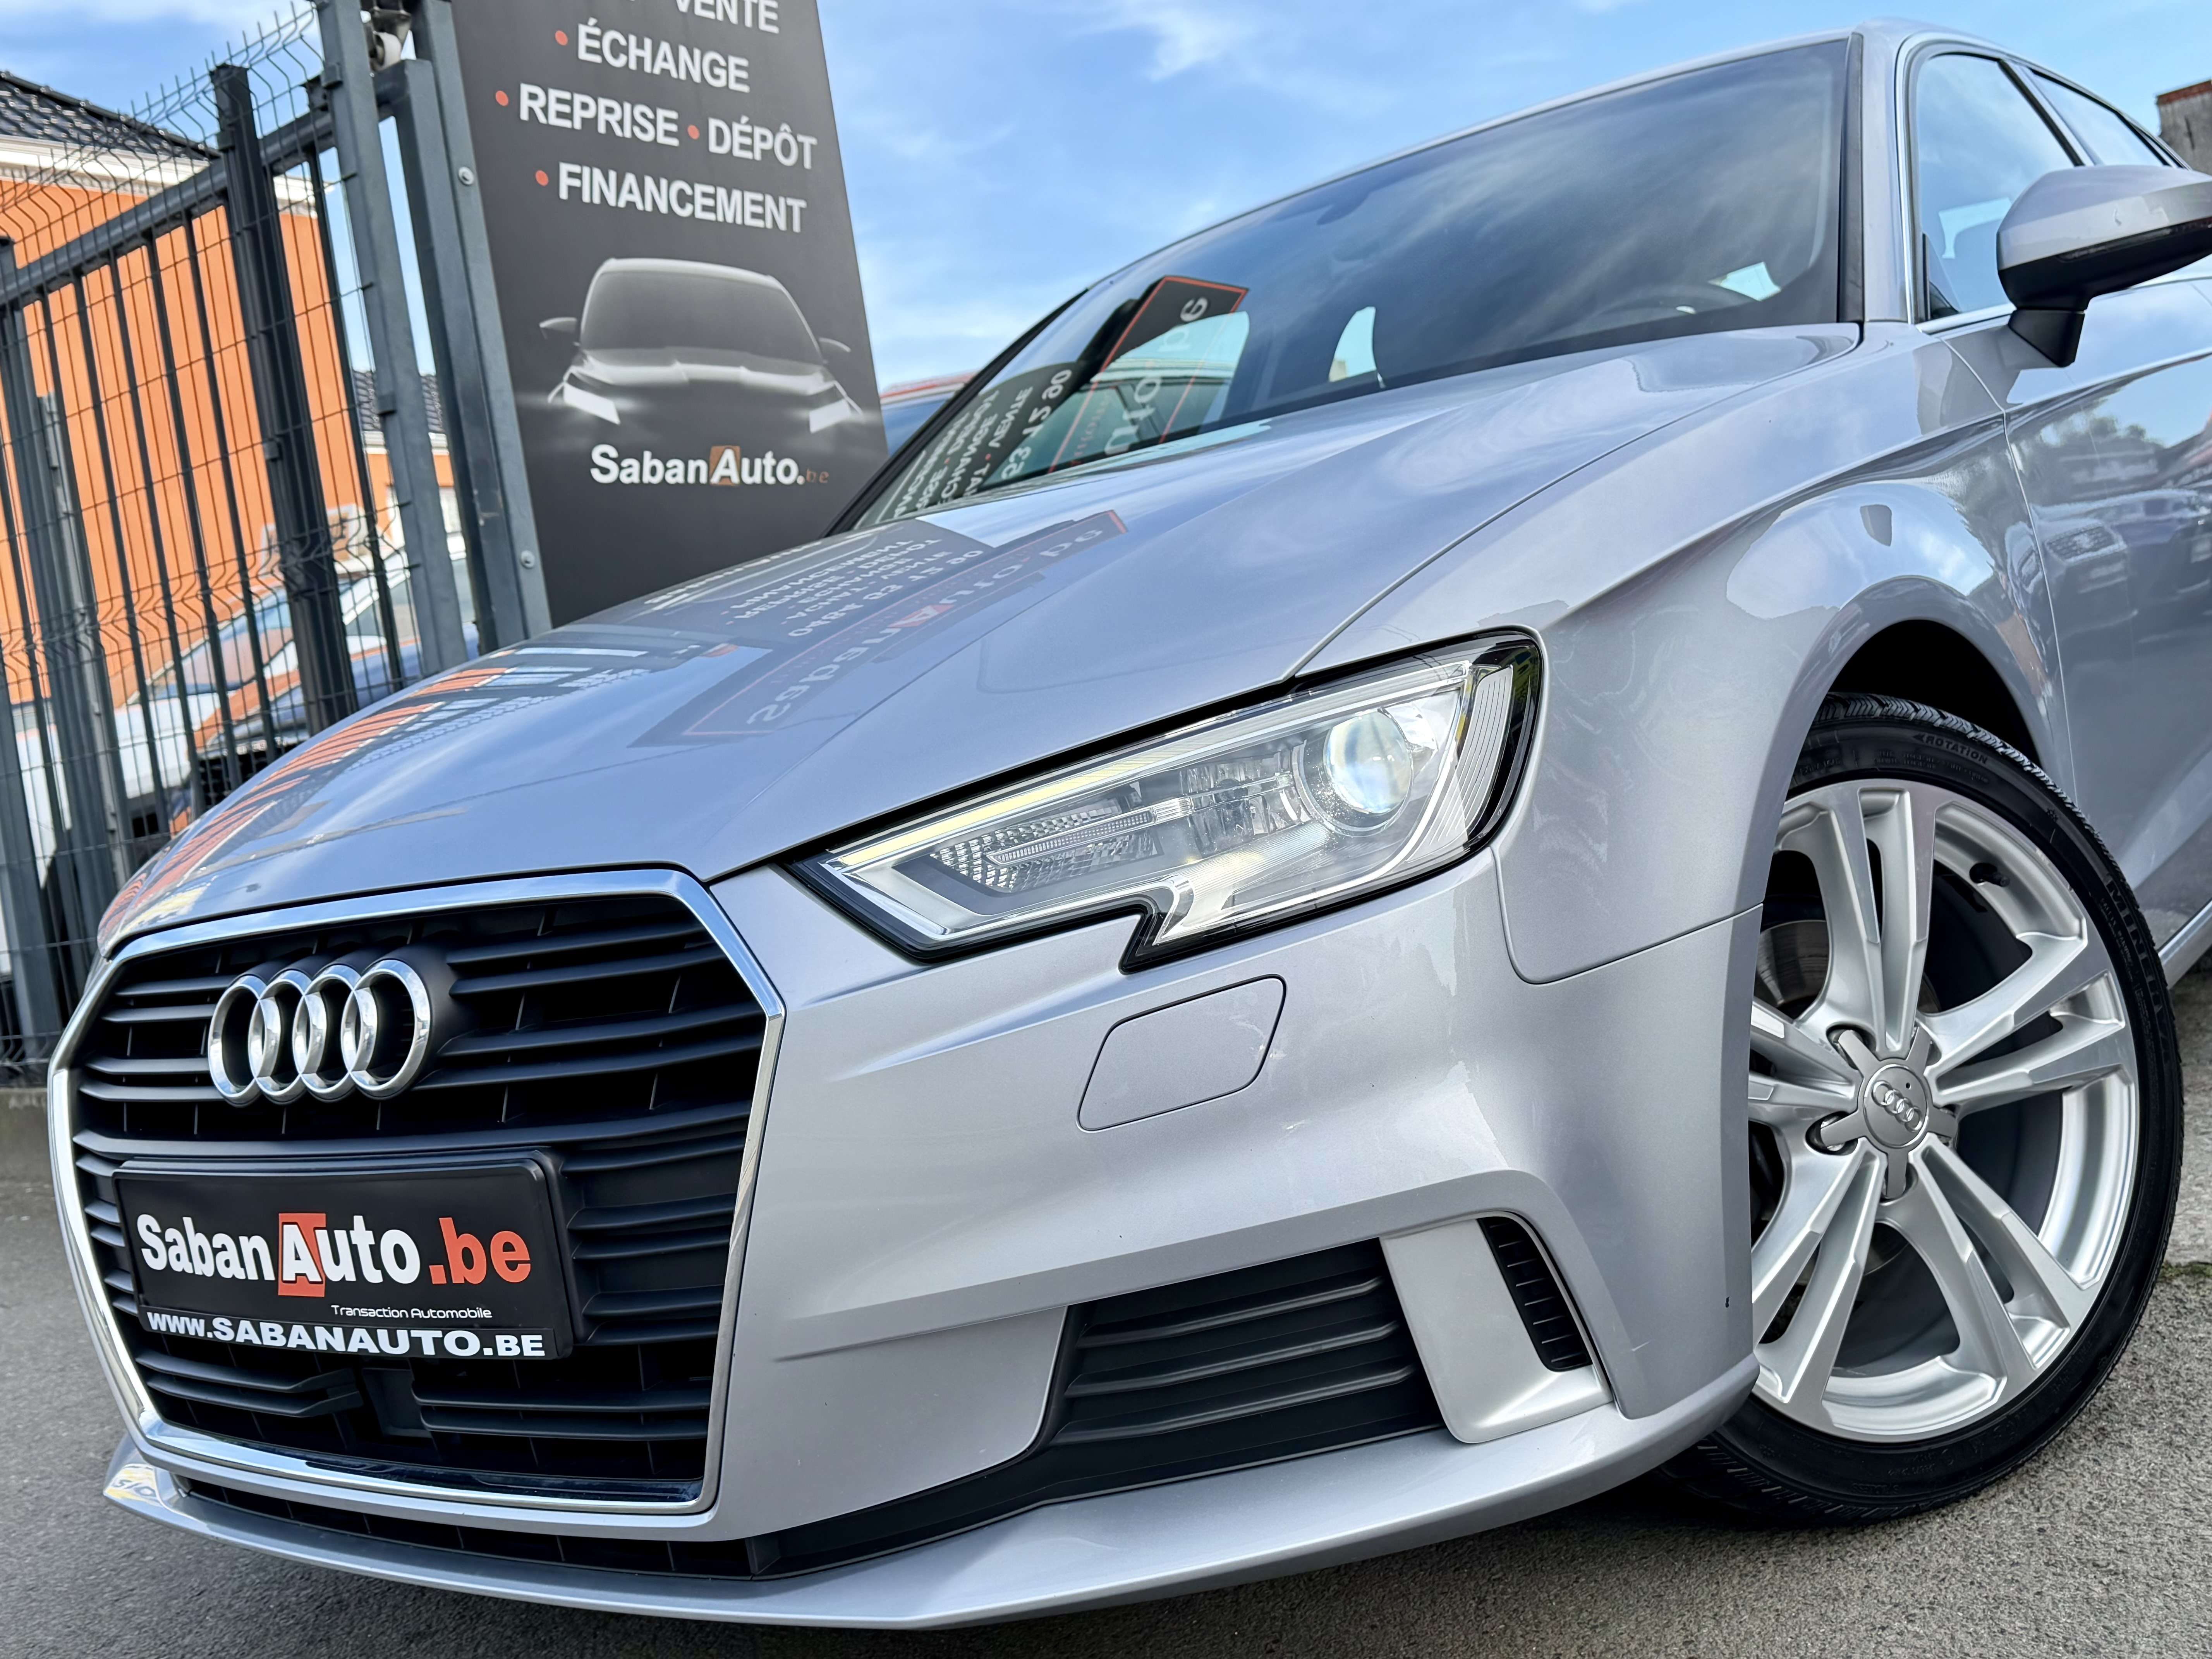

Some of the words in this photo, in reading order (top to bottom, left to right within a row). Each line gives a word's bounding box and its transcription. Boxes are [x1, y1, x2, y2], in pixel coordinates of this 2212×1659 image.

[577, 17, 750, 93] ÉCHANGE
[519, 82, 680, 147] REPRISE
[708, 116, 817, 170] DÉPÔT
[558, 162, 807, 233] FINANCEMENT
[1925, 735, 1988, 764] ROTATION
[137, 1213, 531, 1285] SabanAuto.be
[331, 1305, 409, 1318] Transaction
[410, 1307, 493, 1319] Automobile
